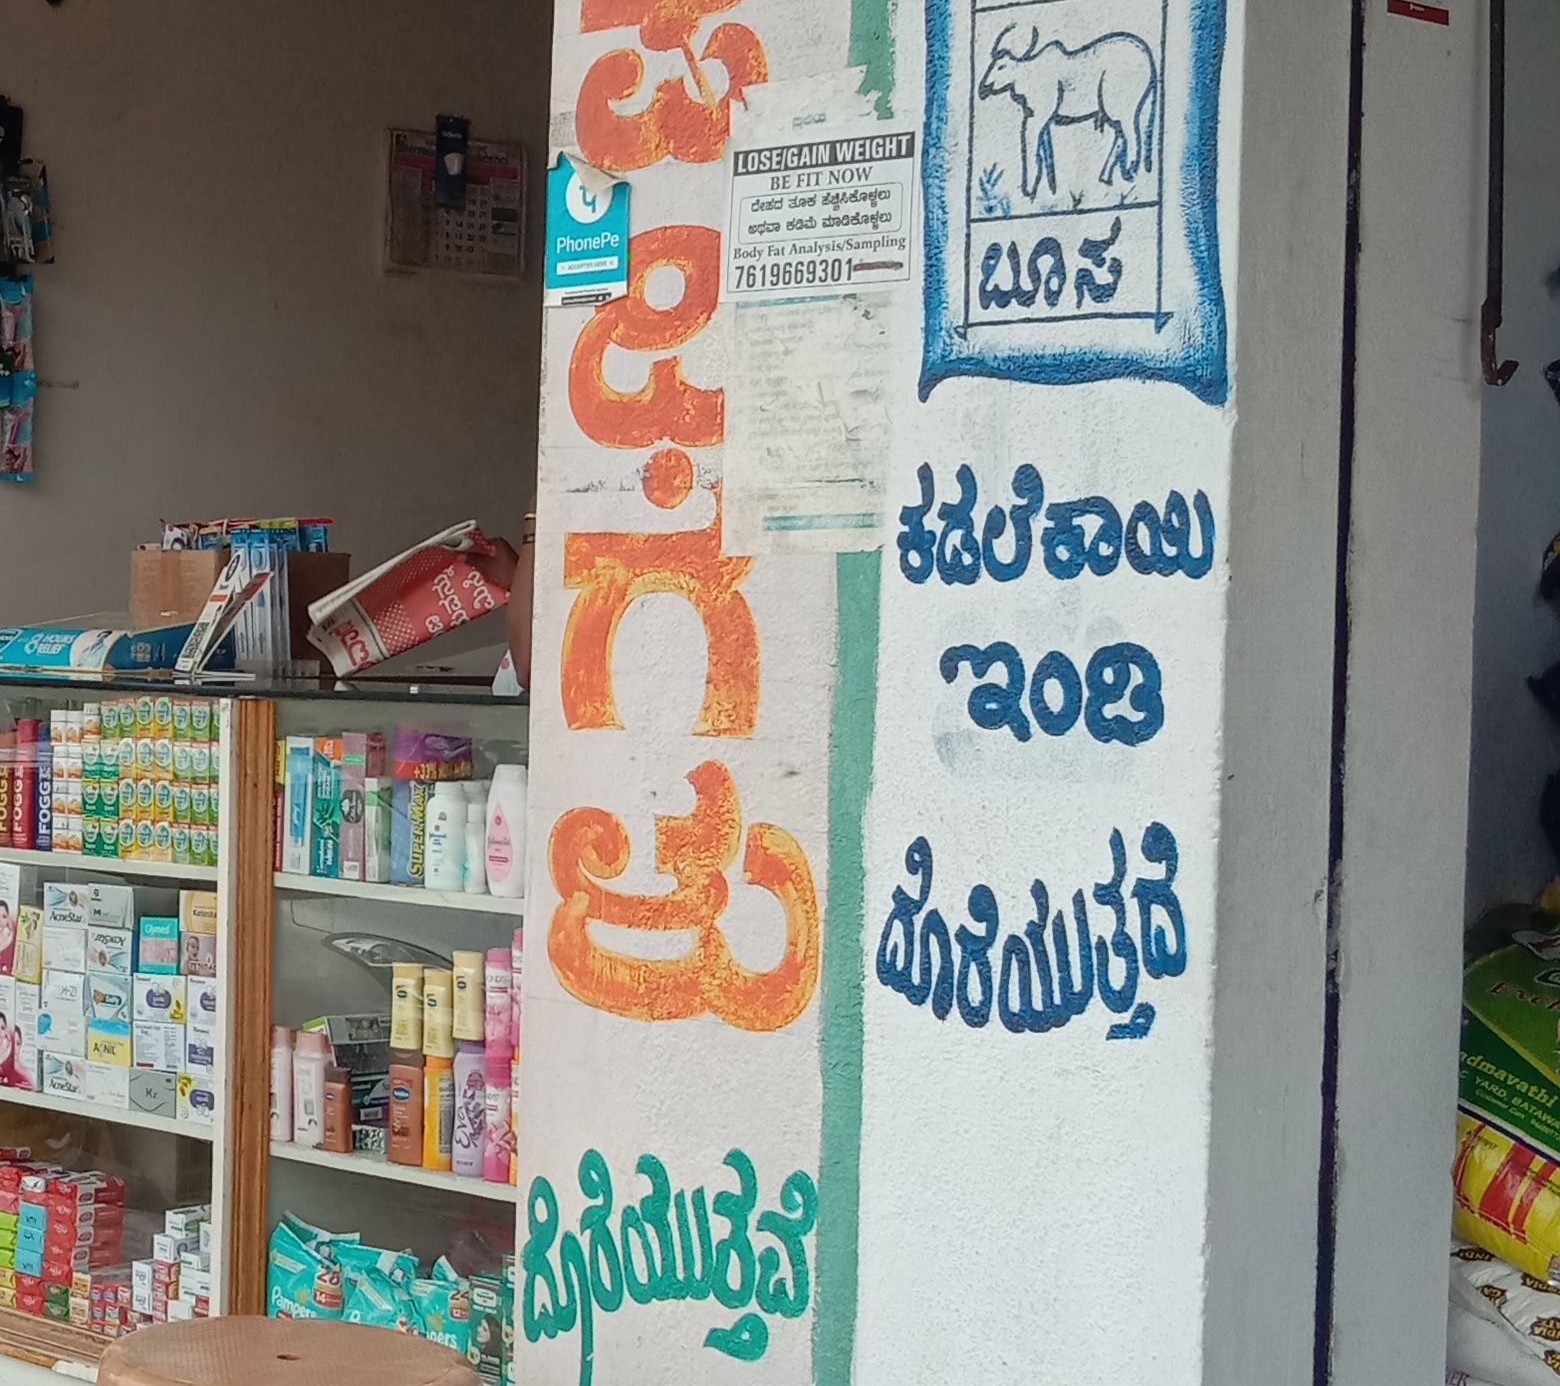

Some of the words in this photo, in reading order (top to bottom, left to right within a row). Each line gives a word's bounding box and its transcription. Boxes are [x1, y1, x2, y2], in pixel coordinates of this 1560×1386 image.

[737, 143, 830, 173] LOSE/GAIN
[835, 134, 911, 164] WEIGHT
[770, 175, 791, 191] BE
[796, 171, 823, 188] FIT
[827, 166, 874, 186] NOW
[557, 231, 620, 254] PhonePe
[733, 247, 768, 262] Body
[767, 245, 786, 257] Fat
[788, 235, 907, 257] Analysis/Sampling
[734, 257, 853, 290] 7619669301
